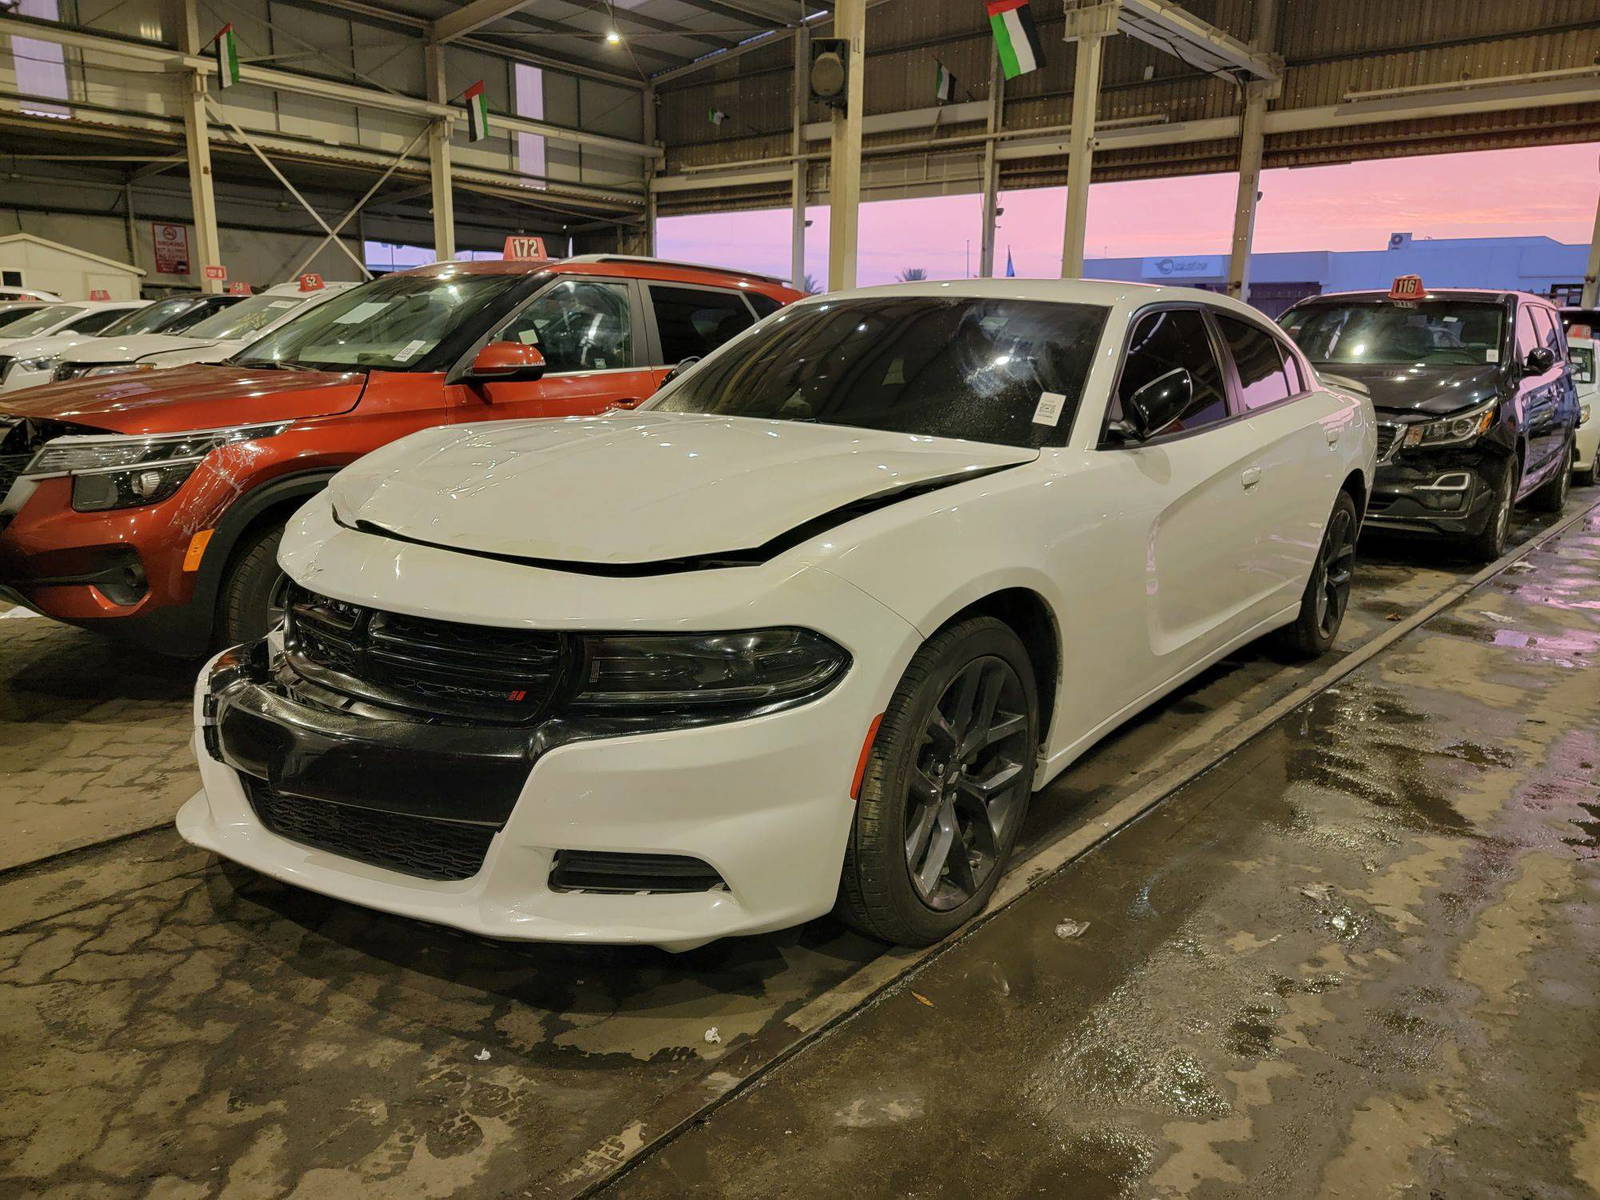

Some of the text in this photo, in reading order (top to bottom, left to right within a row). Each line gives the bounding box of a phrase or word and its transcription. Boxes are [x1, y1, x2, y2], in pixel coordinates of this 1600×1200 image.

[513, 239, 539, 257] 172
[305, 276, 318, 287] 52
[1398, 279, 1416, 293] 116
